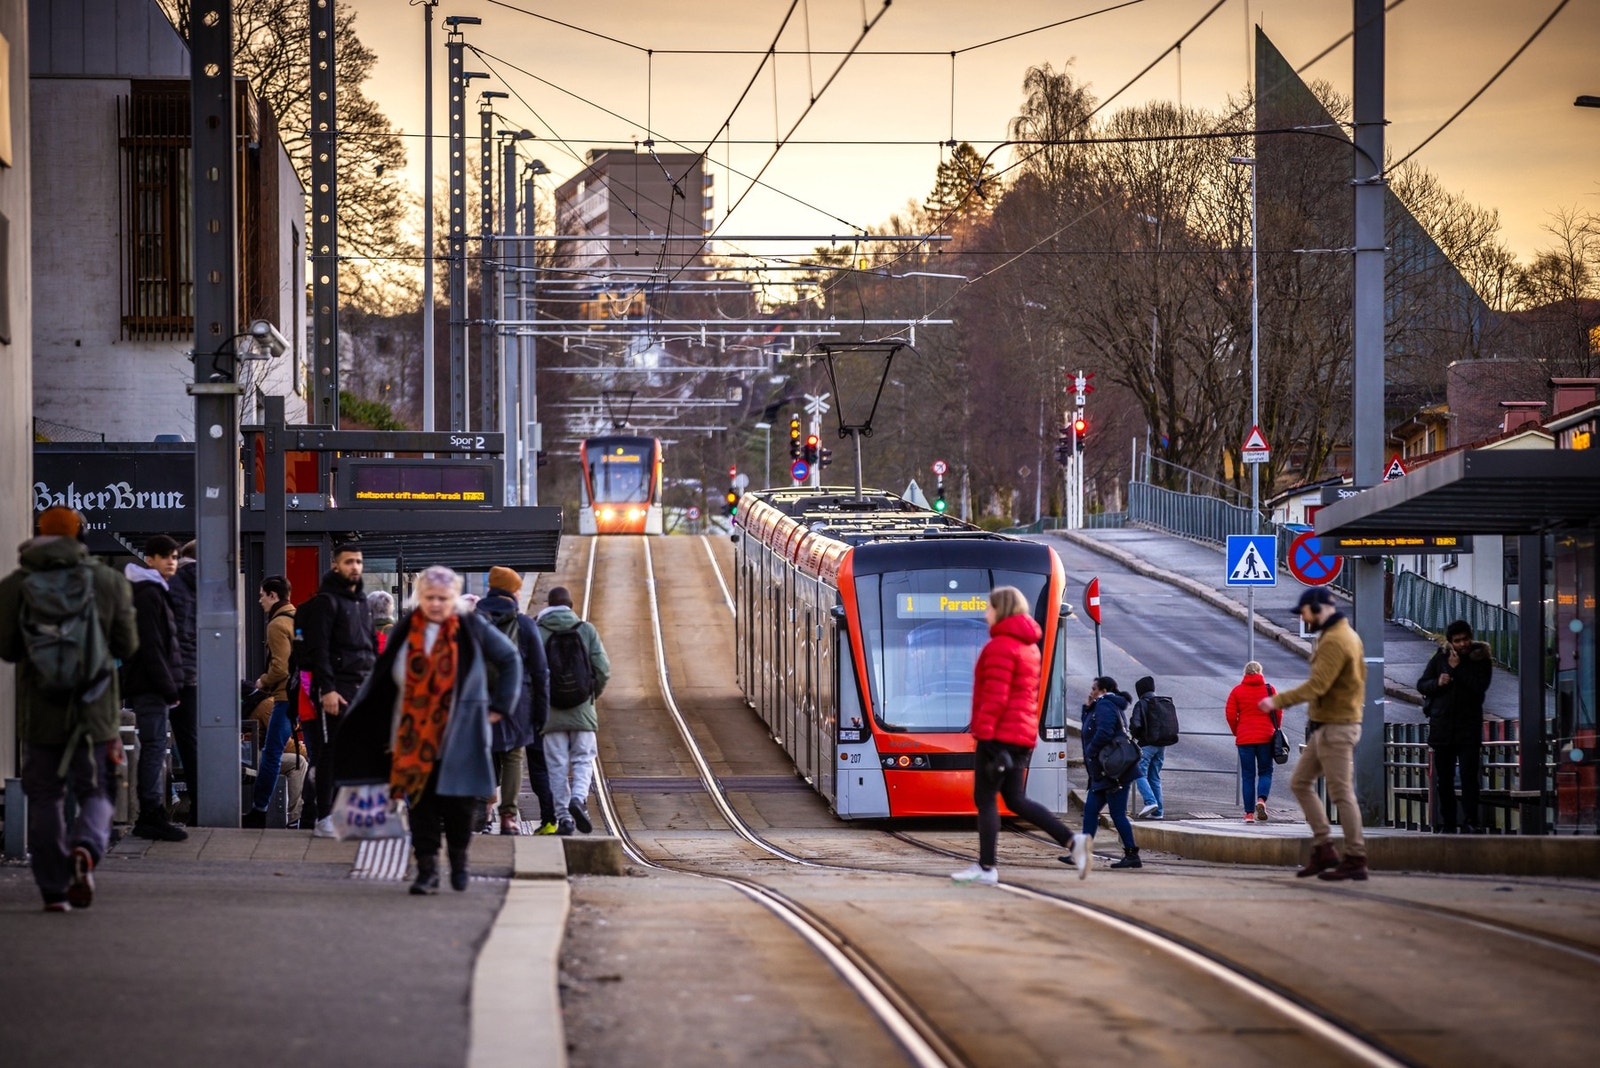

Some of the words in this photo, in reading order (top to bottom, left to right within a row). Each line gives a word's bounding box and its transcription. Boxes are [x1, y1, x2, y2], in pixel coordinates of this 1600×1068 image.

[450, 435, 474, 446] Spor
[475, 436, 485, 449] 2
[395, 491, 411, 499] drift
[412, 492, 434, 500] mellom
[435, 492, 461, 500] Paradis
[907, 596, 914, 611] 1
[940, 596, 987, 611] Paradis
[850, 753, 861, 764] 207
